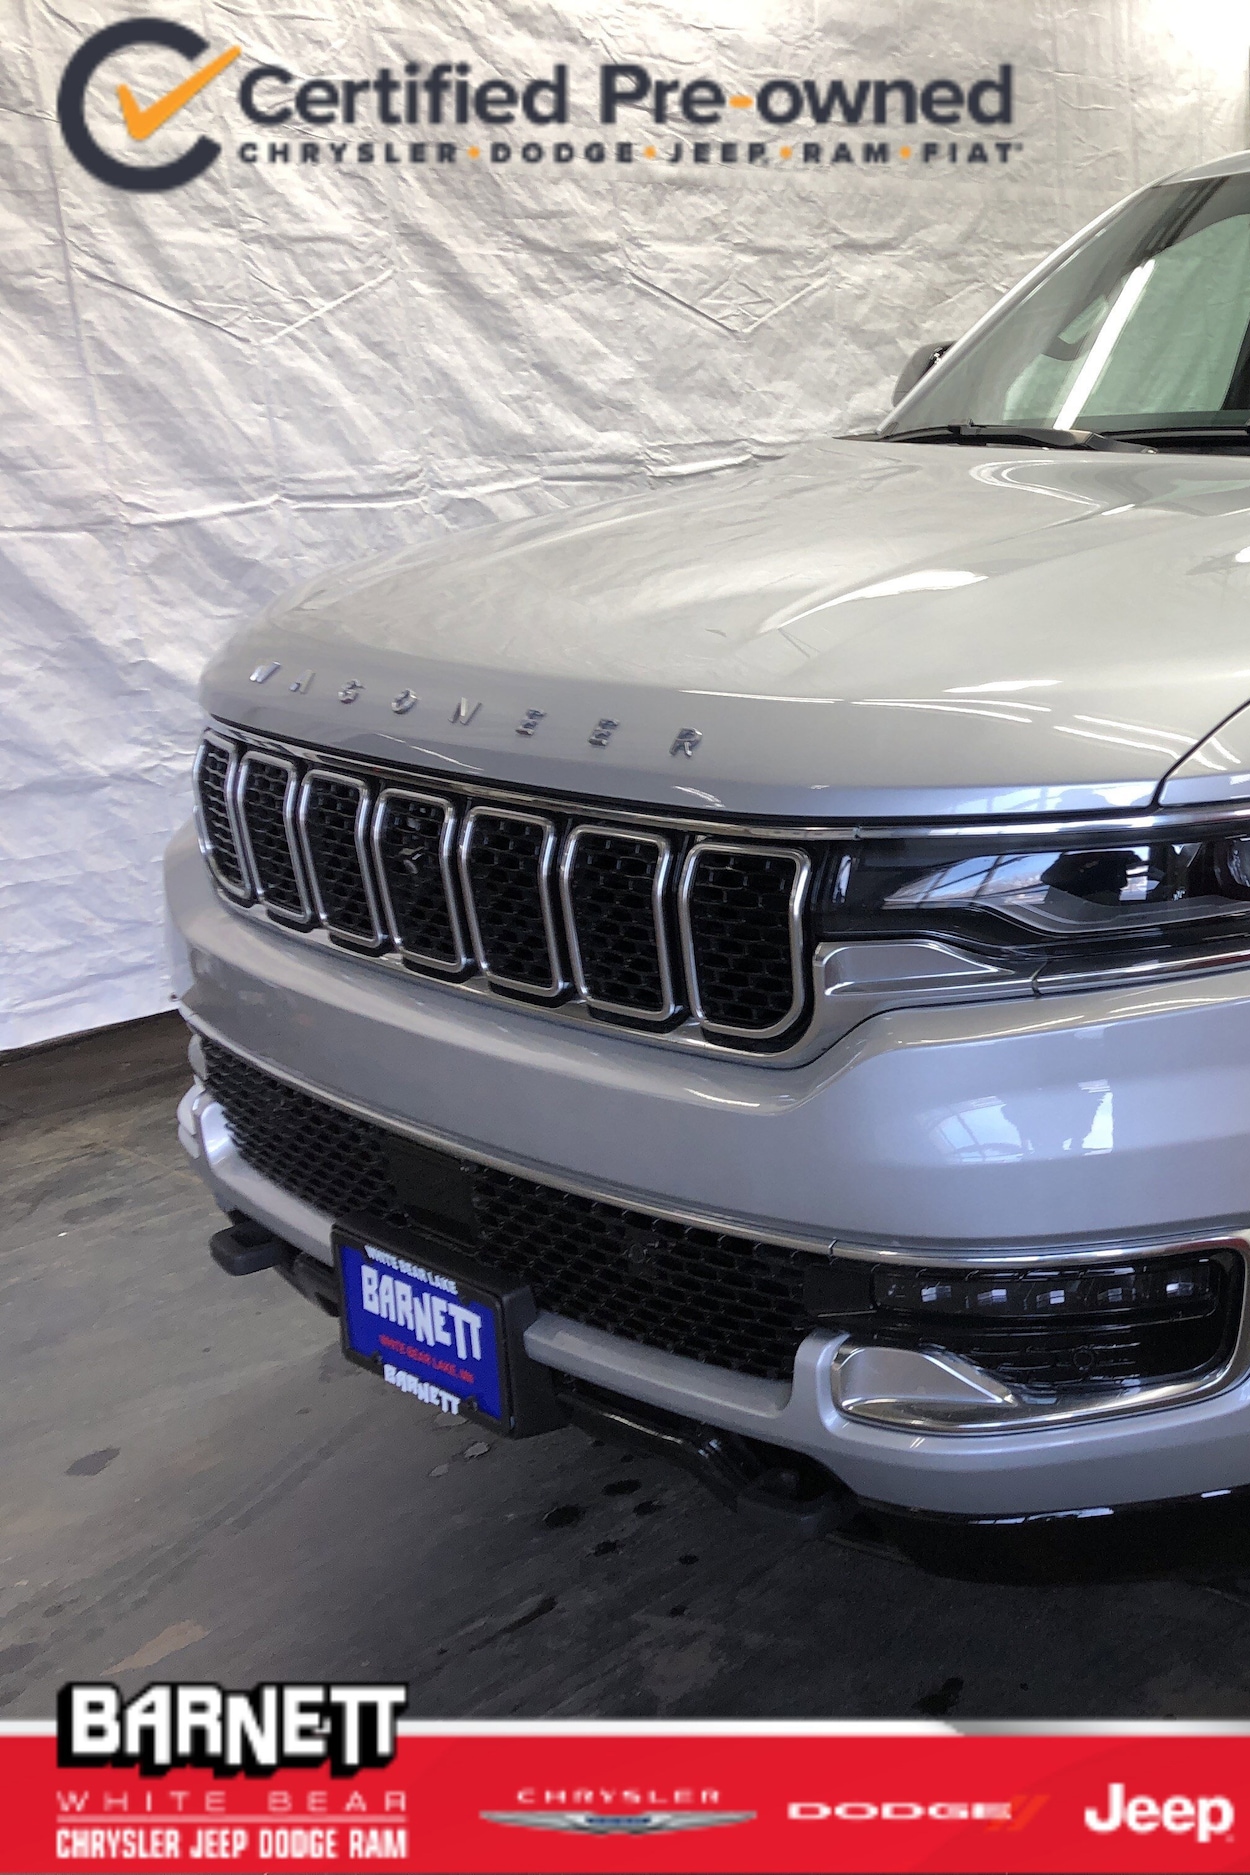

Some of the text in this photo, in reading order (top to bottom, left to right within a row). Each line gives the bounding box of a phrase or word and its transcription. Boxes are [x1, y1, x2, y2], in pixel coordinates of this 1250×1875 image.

[428, 1272, 459, 1296] LAKE
[361, 1263, 482, 1361] BARNETT
[383, 1362, 461, 1415] BARNETT
